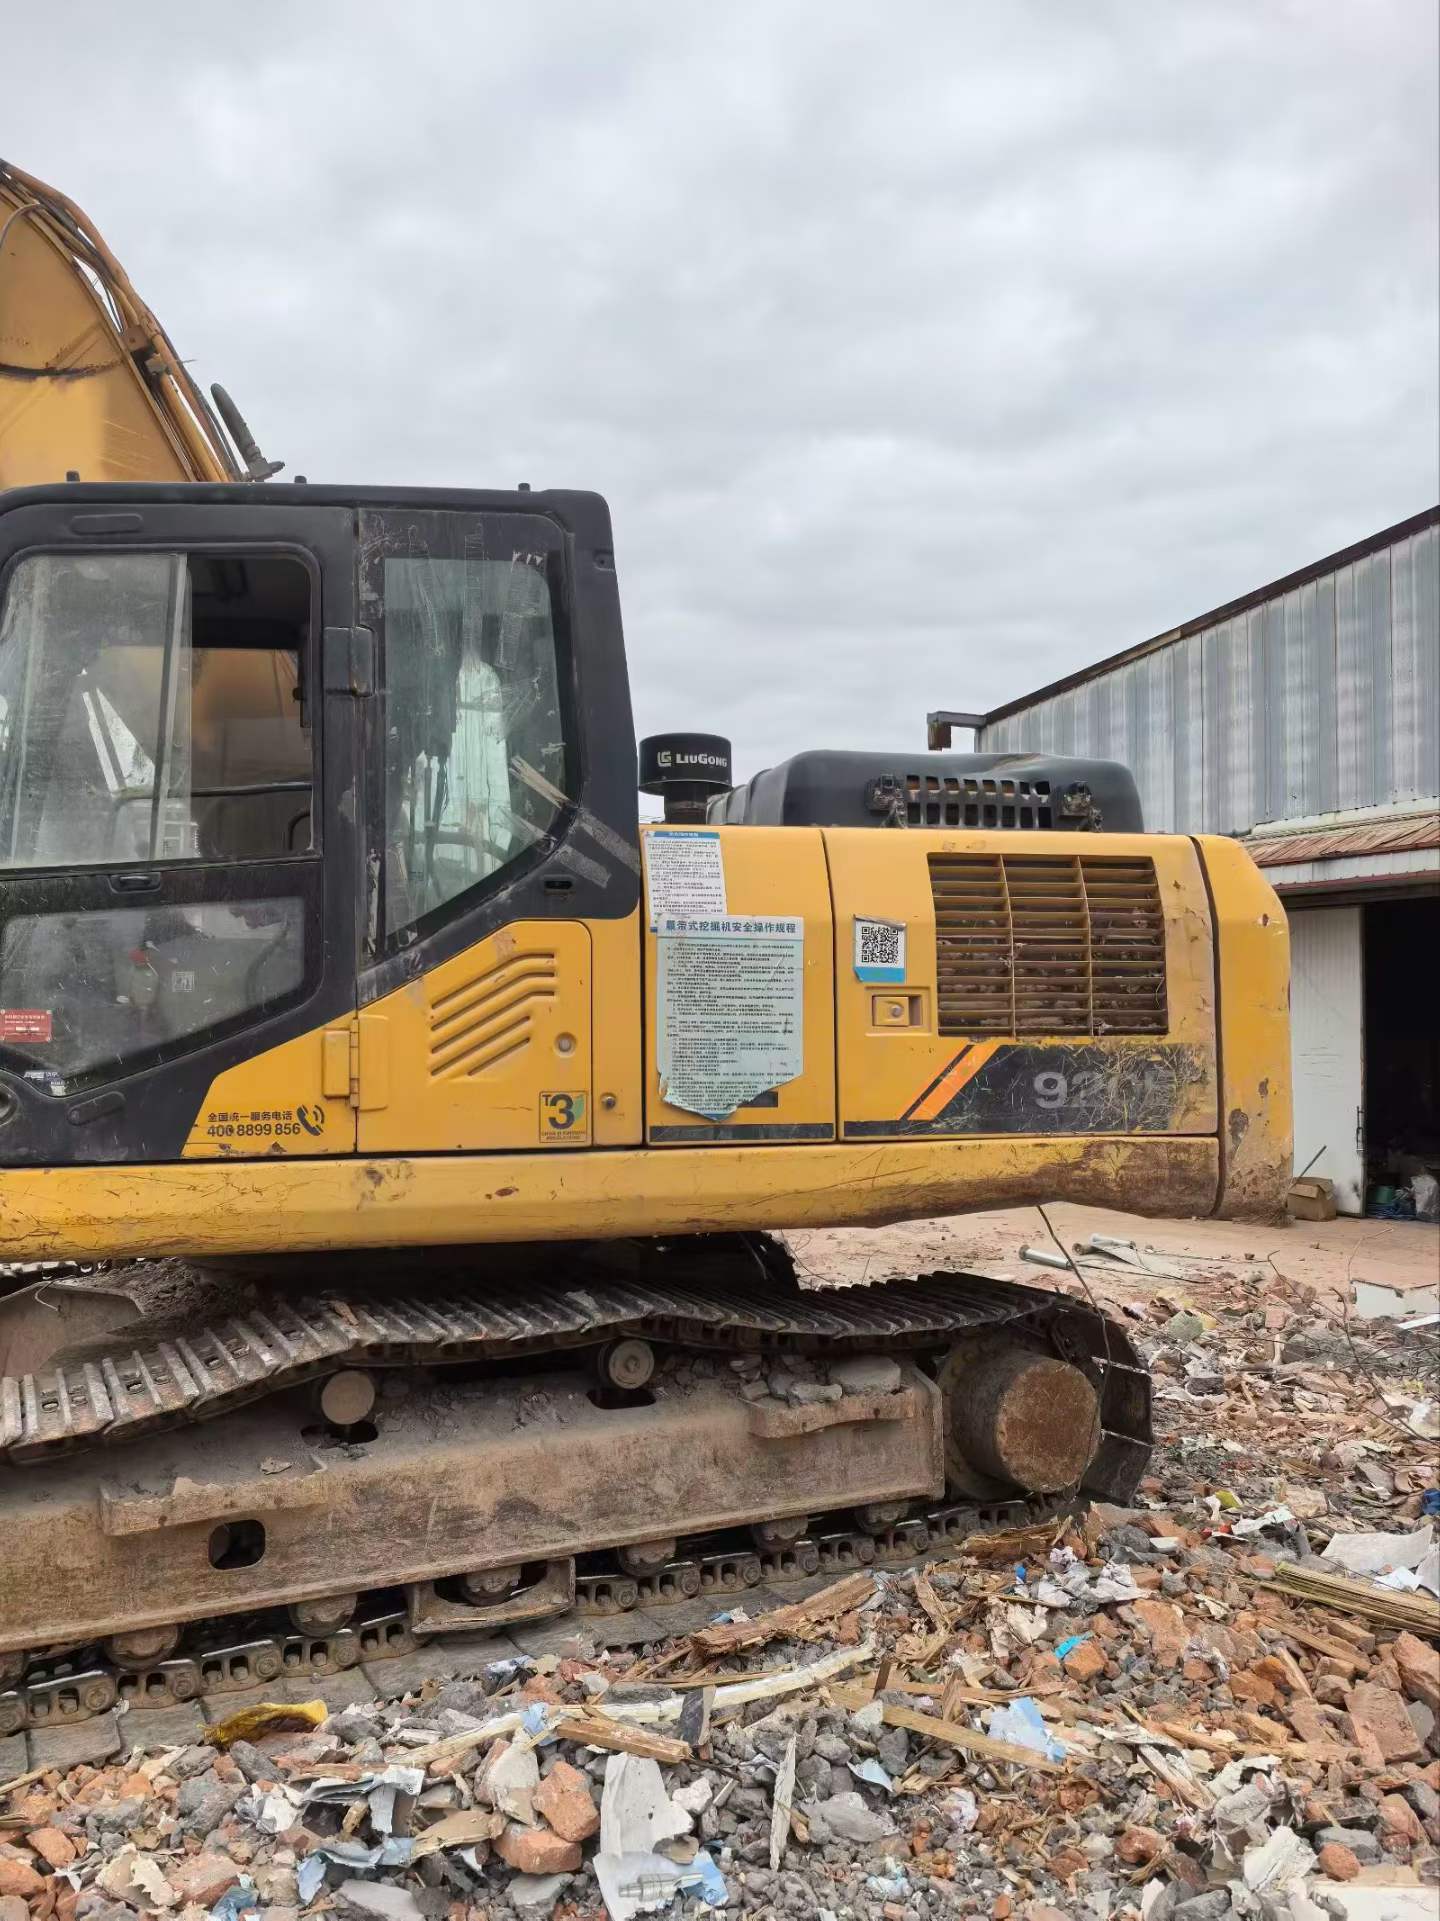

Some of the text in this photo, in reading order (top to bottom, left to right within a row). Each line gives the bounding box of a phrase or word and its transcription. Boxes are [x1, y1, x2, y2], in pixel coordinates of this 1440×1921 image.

[207, 1110, 293, 1122] 全国统一服务电话
[236, 1123, 272, 1136] 8899
[274, 1122, 301, 1135] 856
